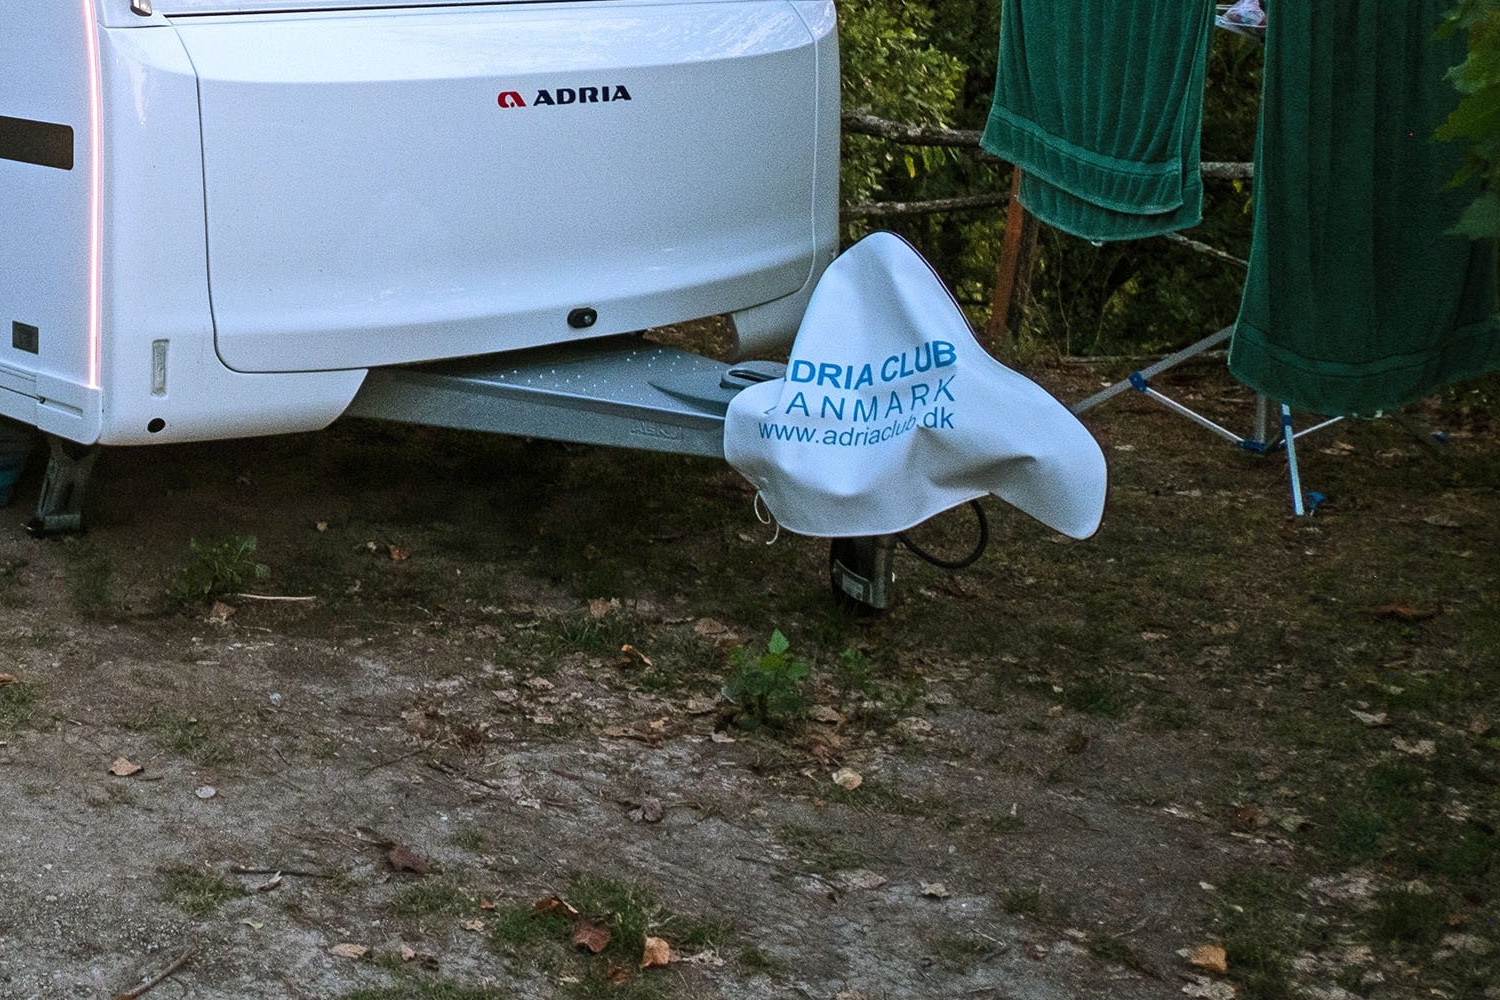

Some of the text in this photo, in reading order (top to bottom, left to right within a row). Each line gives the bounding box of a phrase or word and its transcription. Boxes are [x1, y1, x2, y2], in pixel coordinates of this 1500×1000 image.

[533, 84, 632, 106] ADRIA
[790, 340, 957, 390] DRIA CLUB
[784, 374, 956, 423] ANMARK
[758, 406, 955, 447] www.adriaclub.dk
